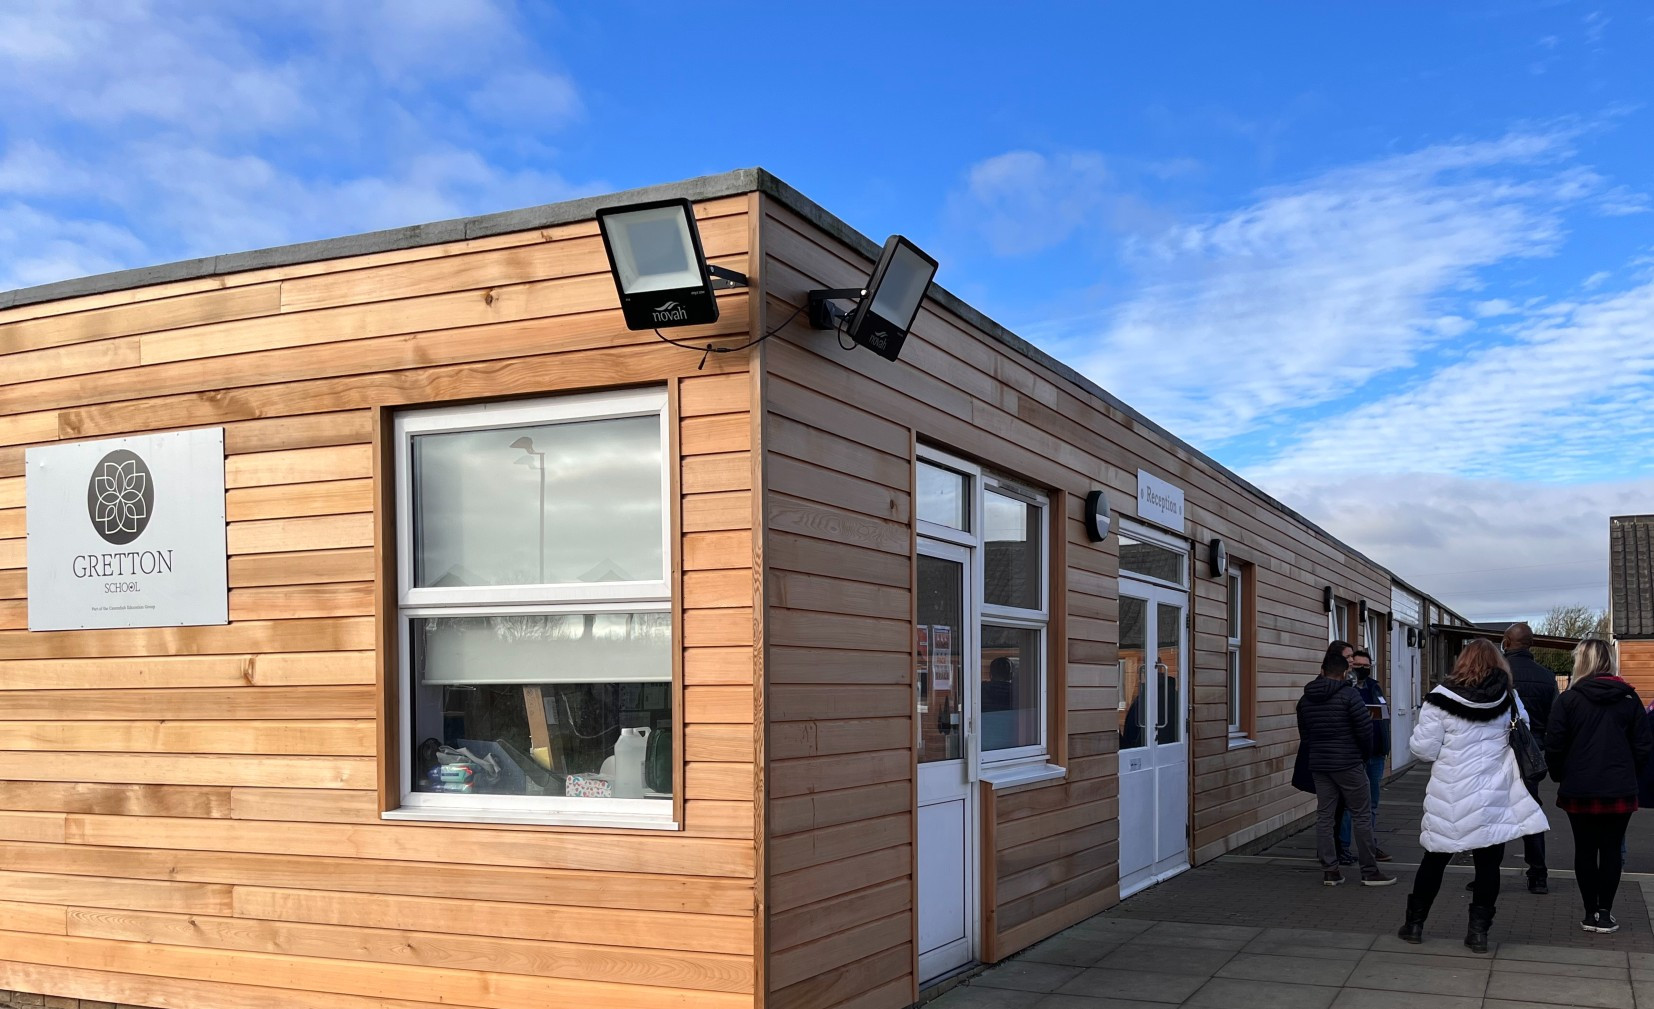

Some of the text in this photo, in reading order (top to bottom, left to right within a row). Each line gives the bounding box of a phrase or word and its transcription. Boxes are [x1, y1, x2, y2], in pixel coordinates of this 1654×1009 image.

[652, 306, 688, 322] novah
[1146, 485, 1177, 514] Reception
[72, 549, 174, 578] GRETTON
[104, 581, 141, 594] SCHOOL
